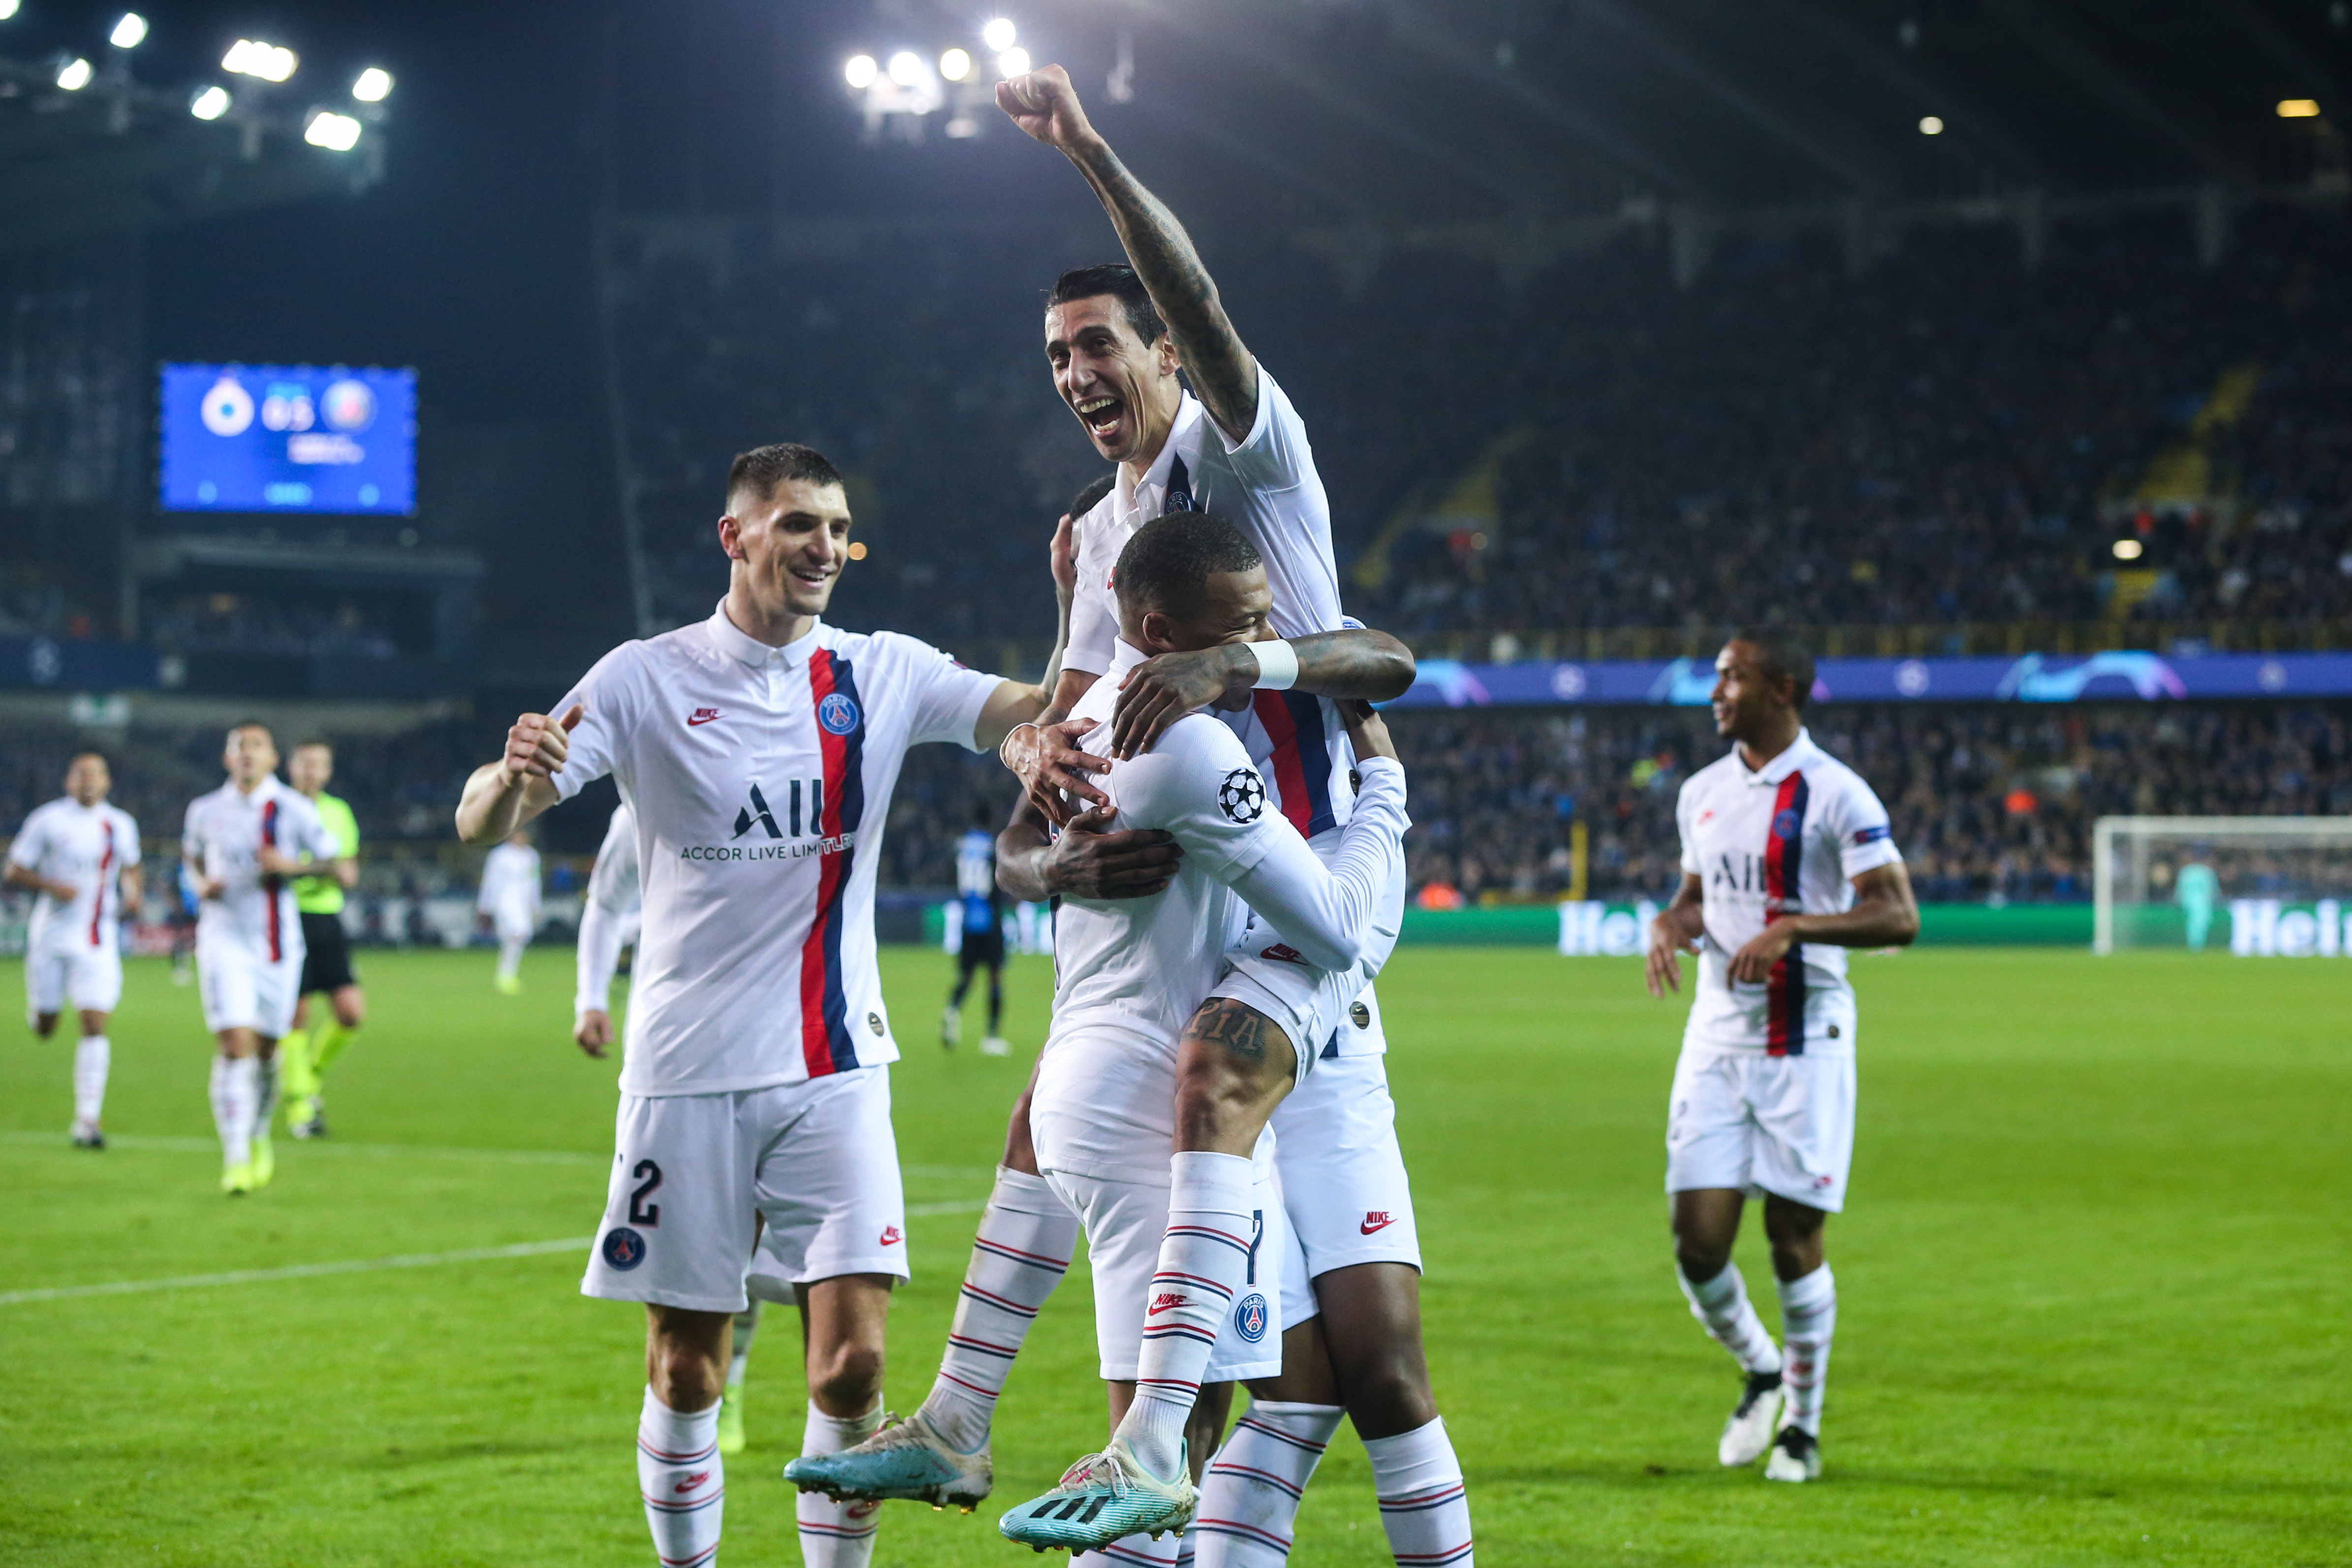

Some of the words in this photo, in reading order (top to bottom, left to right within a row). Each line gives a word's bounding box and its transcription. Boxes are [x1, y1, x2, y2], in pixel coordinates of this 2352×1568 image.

[681, 847, 742, 860] ACCOR
[749, 846, 786, 860] LIVE
[1187, 1002, 1259, 1050] PIA
[1366, 1211, 1389, 1224] NIKE
[1155, 1293, 1187, 1306] NIKE
[1243, 1297, 1264, 1310] PARIS
